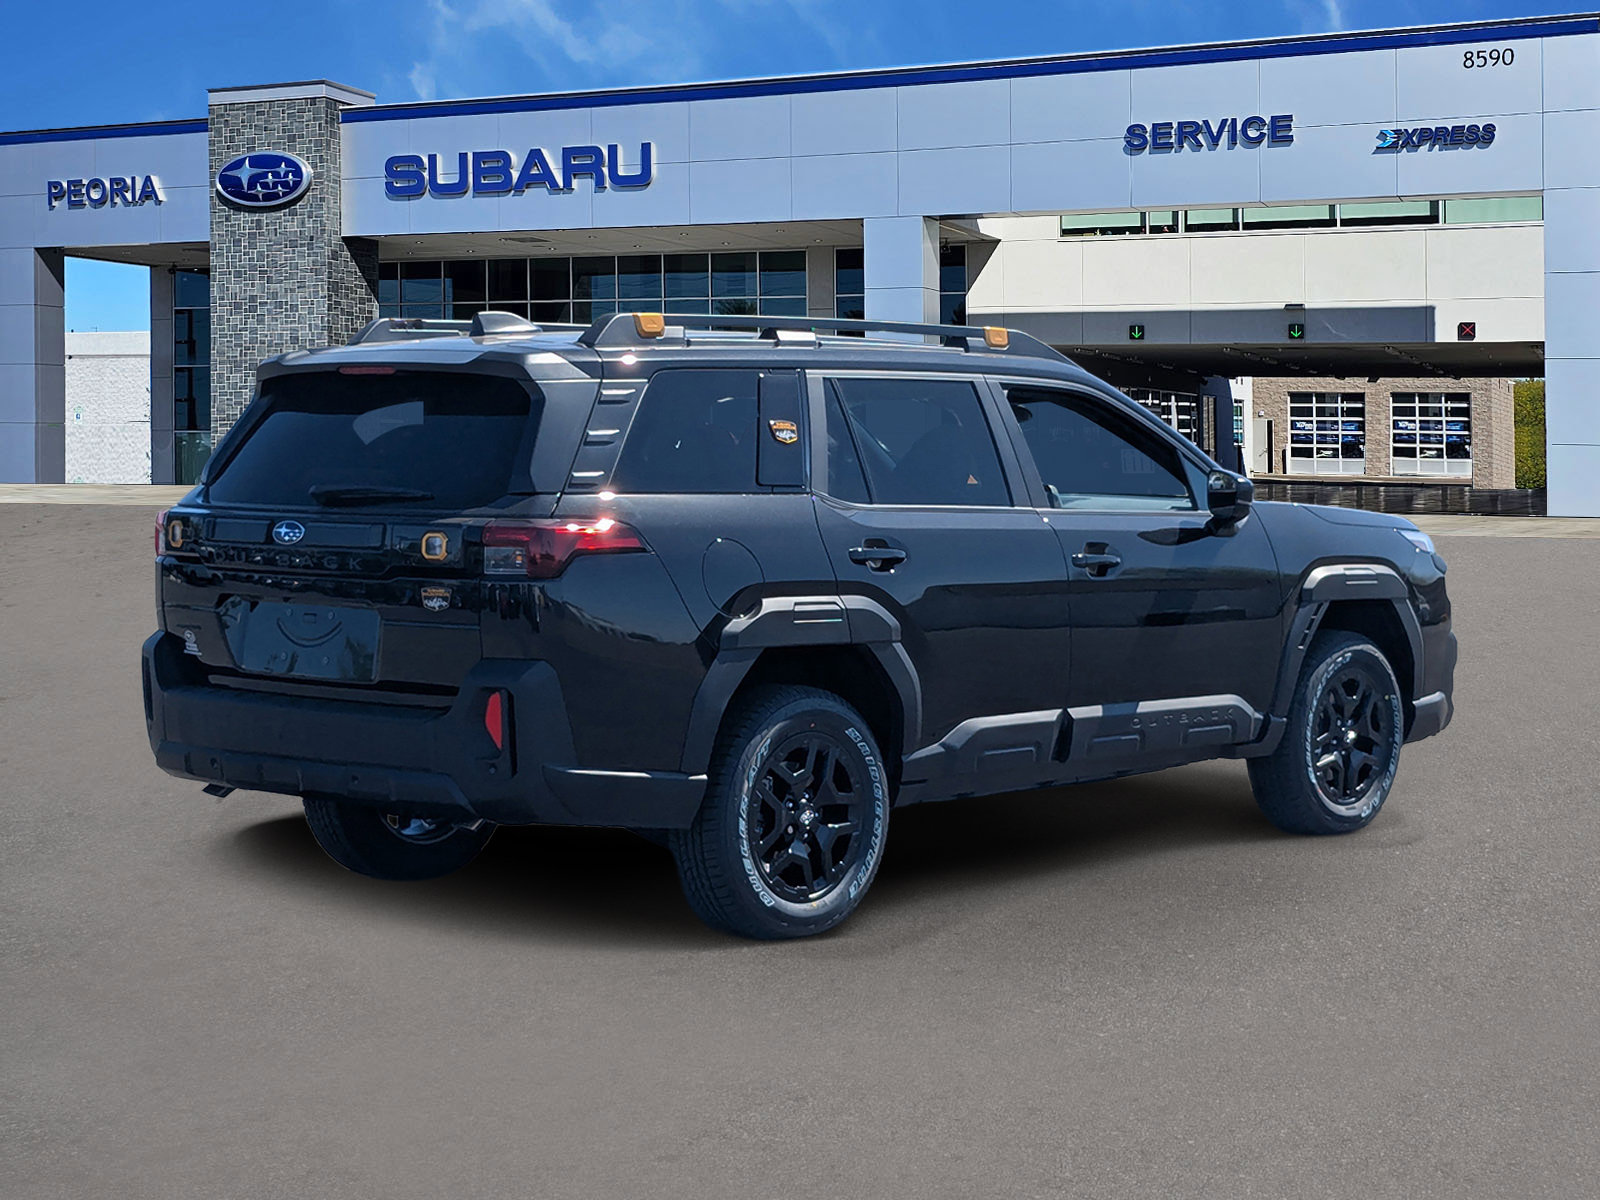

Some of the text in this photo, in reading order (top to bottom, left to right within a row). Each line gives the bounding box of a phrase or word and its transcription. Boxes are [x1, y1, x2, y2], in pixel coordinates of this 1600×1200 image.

[1463, 48, 1514, 69] 8590
[1125, 114, 1294, 151] SERVICE
[1376, 123, 1496, 150] EXPRESS
[384, 142, 651, 196] SUBARU
[47, 175, 160, 207] PEORIA
[845, 727, 884, 899] BRIDGESTONE
[738, 794, 775, 908] DUELER
